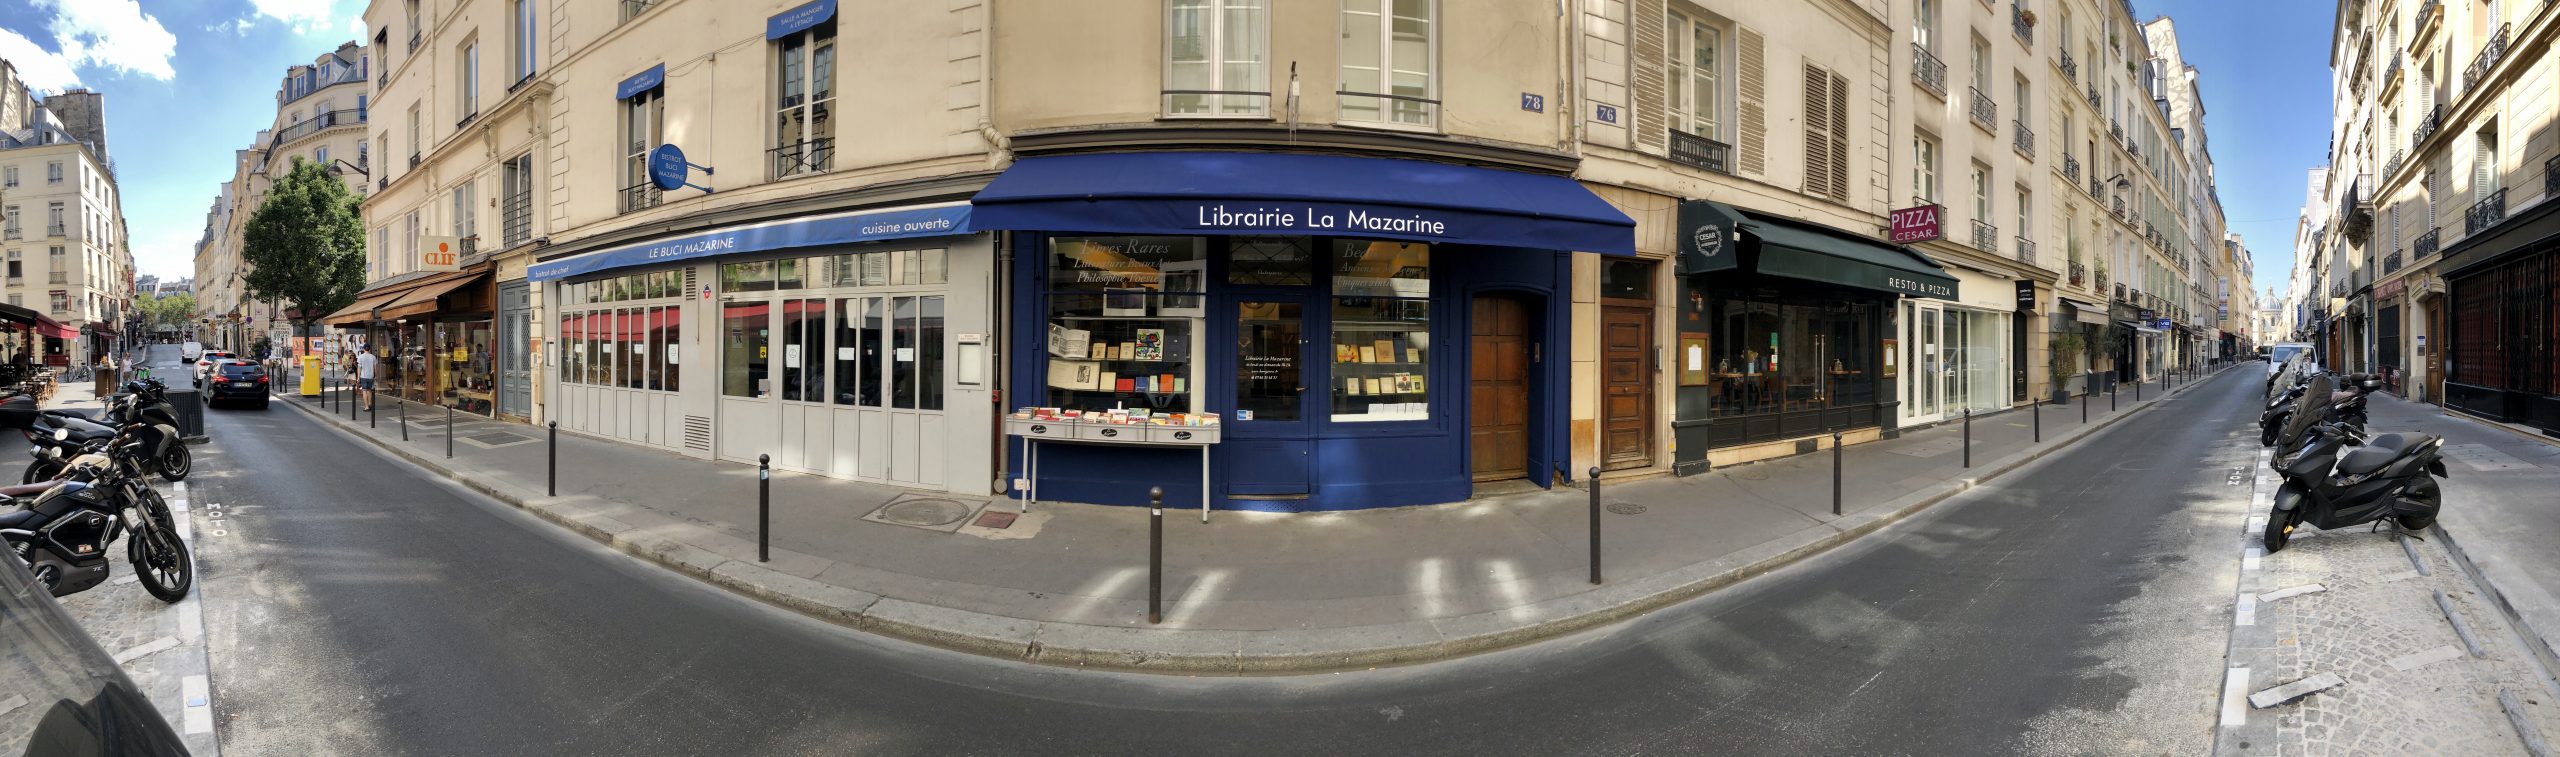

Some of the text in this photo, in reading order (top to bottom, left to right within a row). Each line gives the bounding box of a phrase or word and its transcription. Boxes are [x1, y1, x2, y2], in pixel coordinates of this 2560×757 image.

[1525, 95, 1541, 110] 78
[1600, 107, 1614, 121] 76
[661, 153, 681, 163] BISTROT
[658, 170, 685, 180] MAZARINE
[861, 217, 950, 235] cuisine ouverte
[1199, 204, 1445, 234] Librairie La Mazarine
[1891, 209, 1937, 230] PIZZA
[1699, 232, 1717, 241] CESAR
[1895, 228, 1933, 241] CESAR
[424, 244, 456, 266] CLIF
[649, 237, 734, 258] LE BUCI MAZARINE
[1081, 238, 1171, 255] Livres Rares
[535, 270, 550, 278] bistrot
[558, 264, 570, 274] chef
[1889, 277, 1951, 296] RESTO & PIZZA
[206, 503, 228, 537] MOTO
